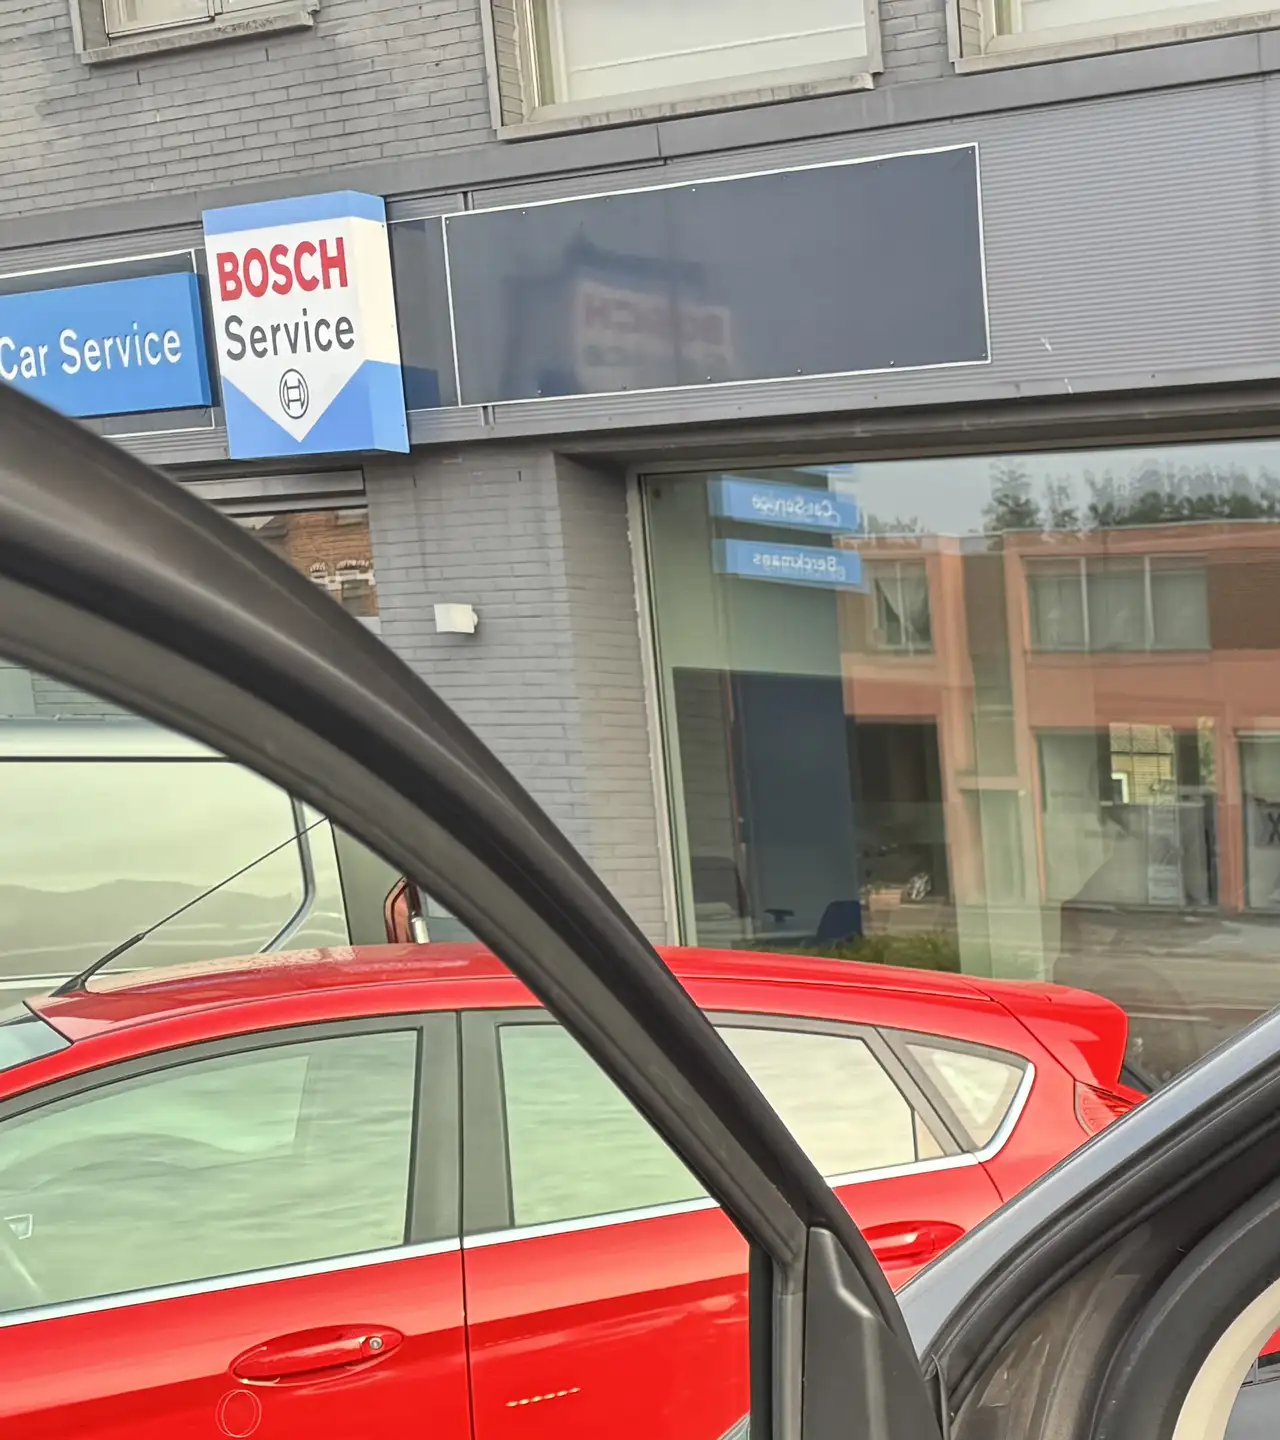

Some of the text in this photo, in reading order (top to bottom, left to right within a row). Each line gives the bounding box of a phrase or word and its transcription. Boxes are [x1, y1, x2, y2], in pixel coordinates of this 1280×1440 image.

[216, 237, 348, 301] BOSCH
[0, 320, 182, 380] Car Service
[223, 307, 355, 361] Service
